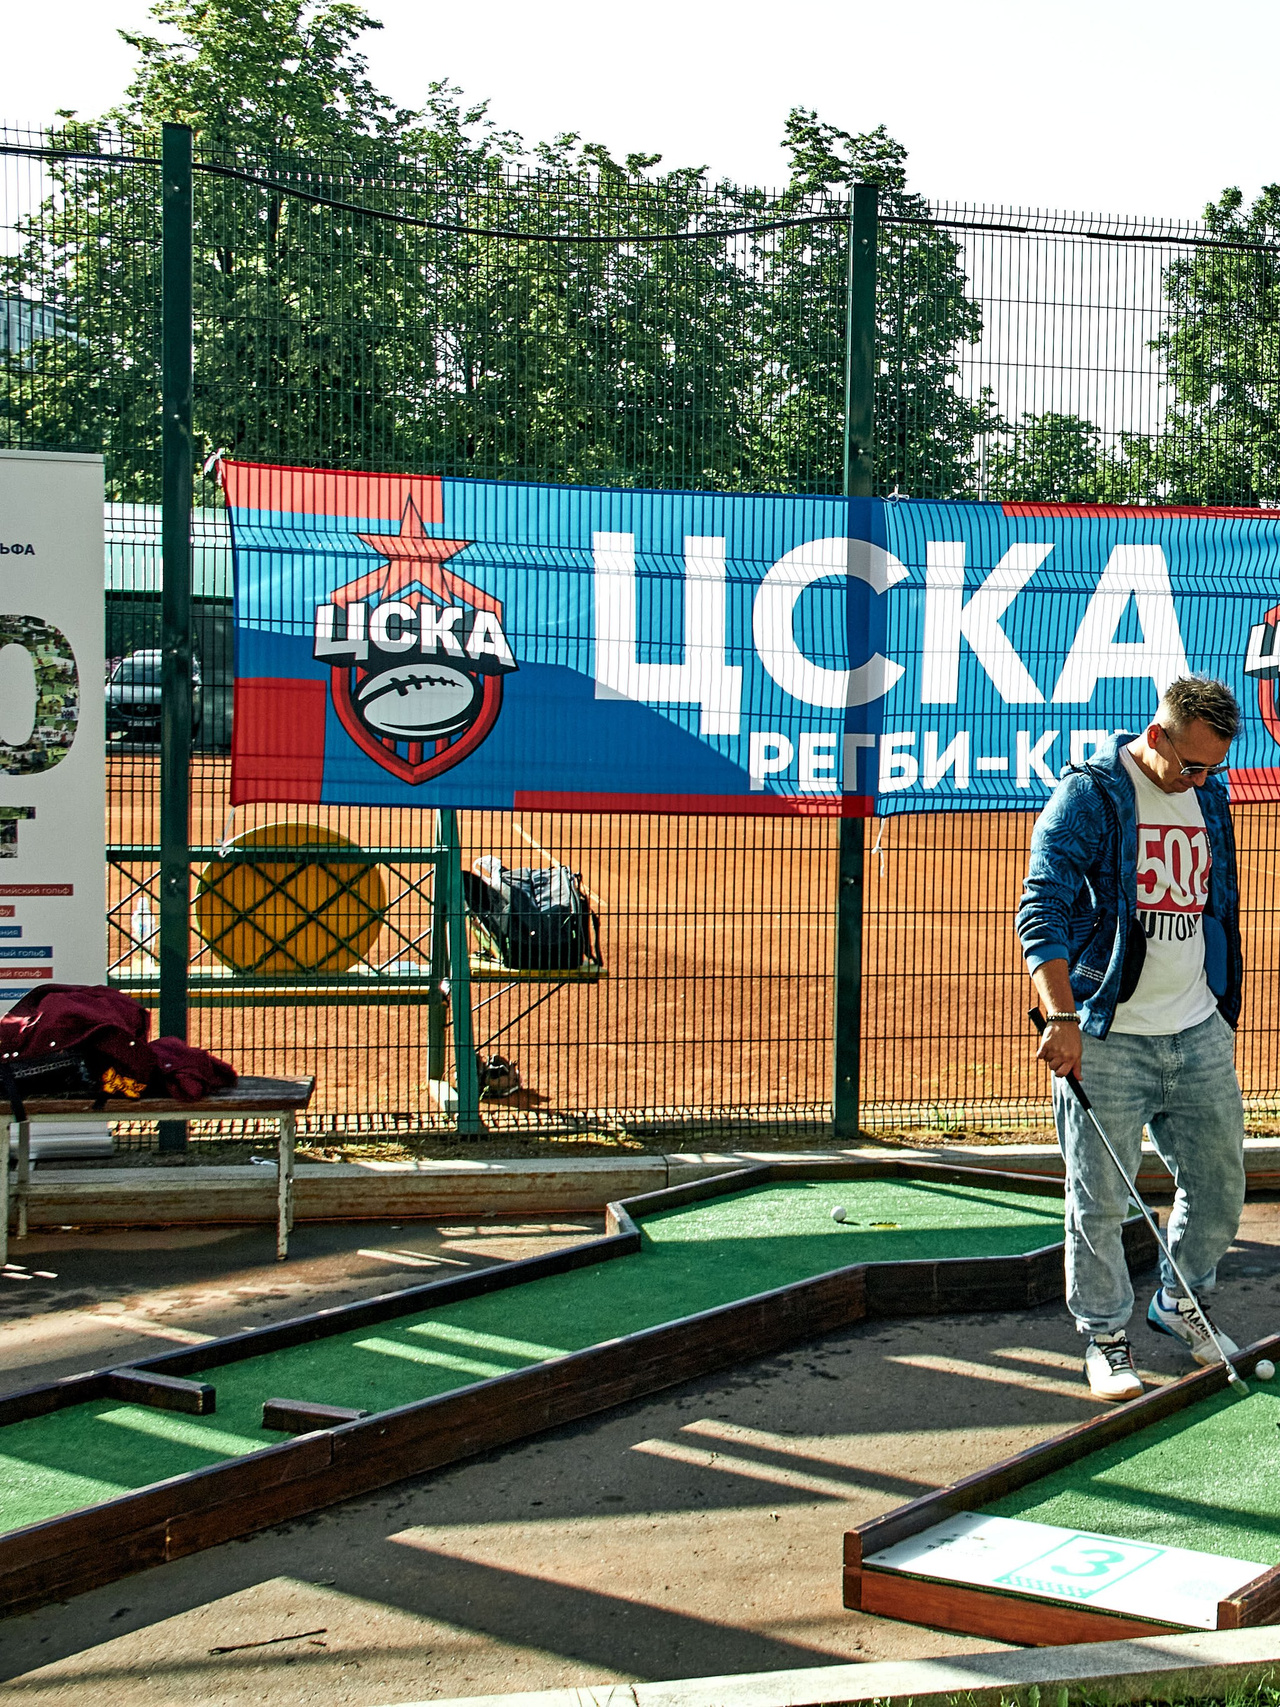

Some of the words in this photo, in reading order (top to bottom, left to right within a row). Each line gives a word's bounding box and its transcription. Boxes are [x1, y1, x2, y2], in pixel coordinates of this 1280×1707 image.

[315, 601, 517, 667] ЦСКА
[592, 531, 1191, 735] ЦСКА
[1050, 1549, 1126, 1577] 3
